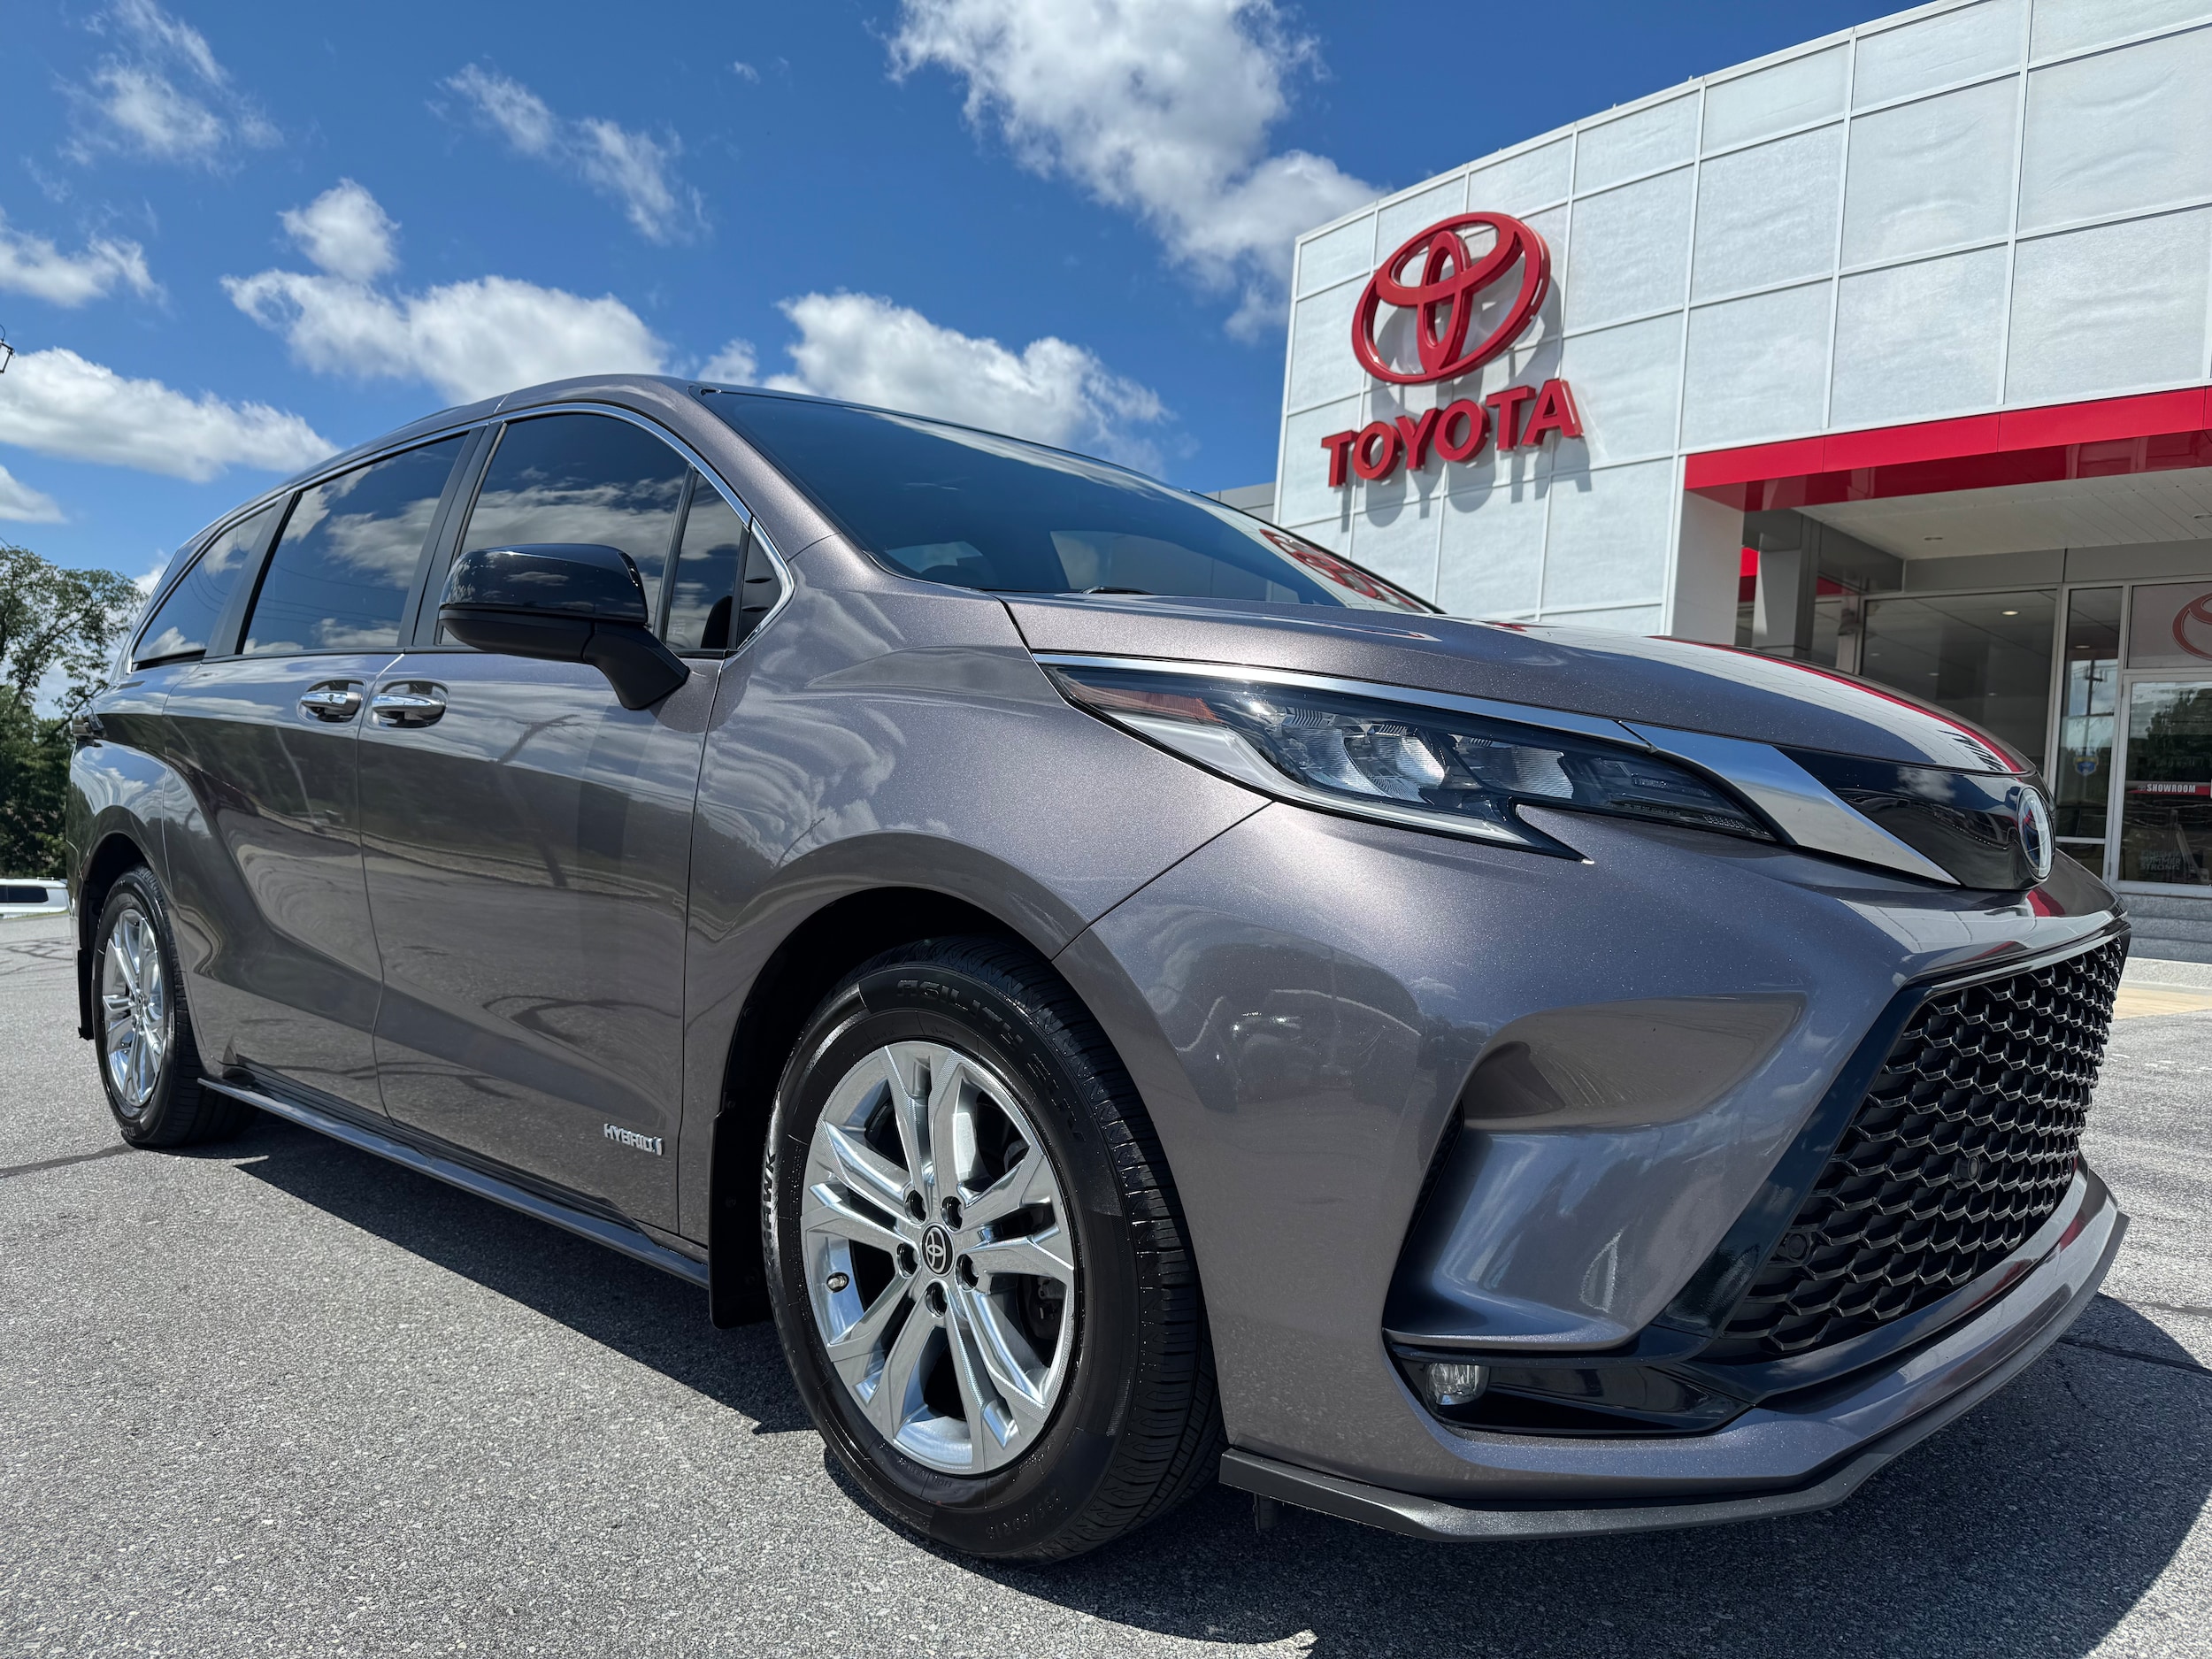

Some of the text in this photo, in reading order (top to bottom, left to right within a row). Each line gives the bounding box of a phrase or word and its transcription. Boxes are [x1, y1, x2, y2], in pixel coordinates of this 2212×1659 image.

[1321, 378, 1584, 488] TOYOTA
[2147, 784, 2196, 794] SHOWROOM
[604, 1124, 656, 1153] HYBRID
